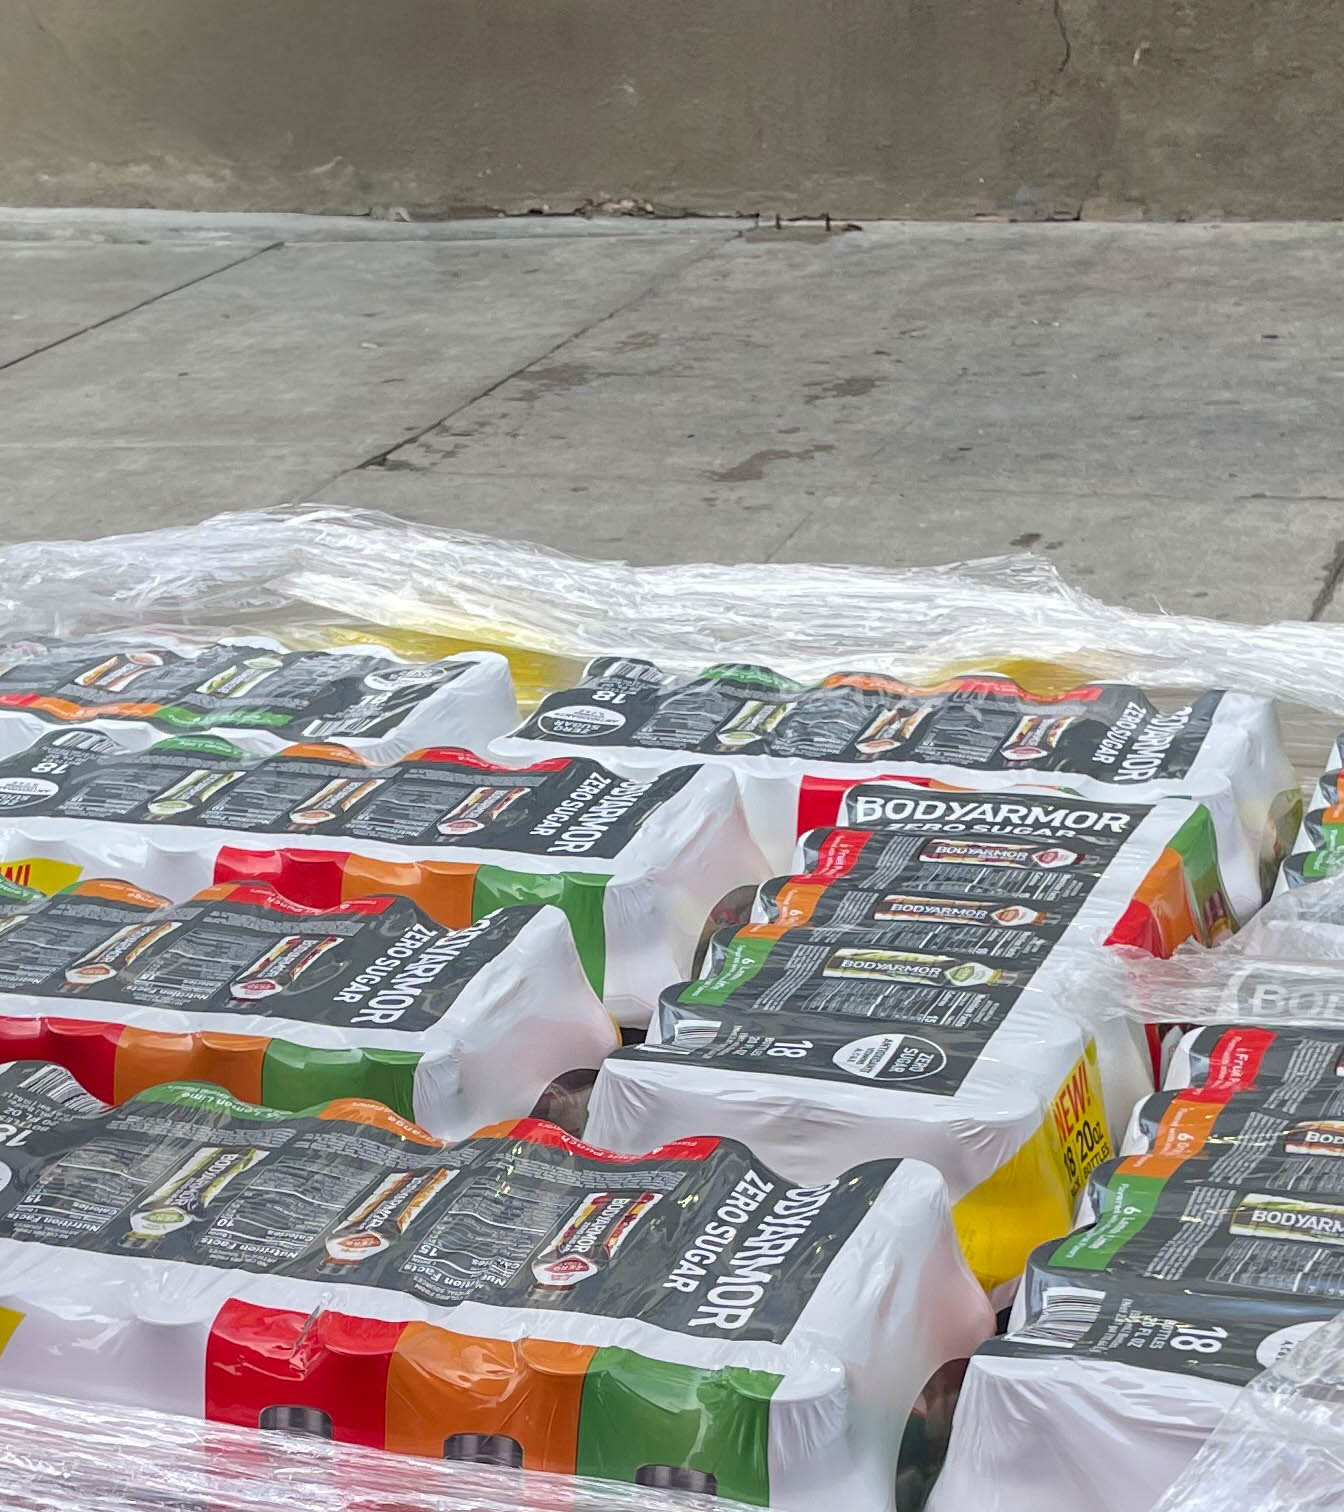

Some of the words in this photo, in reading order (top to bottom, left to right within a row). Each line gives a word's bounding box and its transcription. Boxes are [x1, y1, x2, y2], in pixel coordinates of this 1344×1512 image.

[592, 690, 627, 704] 18
[1116, 701, 1147, 730] ZERO
[1092, 725, 1133, 764] SUGAR
[569, 771, 612, 801] ZERO
[529, 800, 585, 836] SUGAR
[856, 797, 1131, 834] BODYARMOR
[887, 823, 956, 834] ZERO
[964, 823, 1077, 839] SUGAR
[935, 846, 1028, 860] BODYARMOR
[889, 903, 988, 919] BODYARMOR
[387, 923, 438, 957] ZERO
[337, 957, 401, 1004] SUGAR
[841, 959, 942, 979] BODYARMOR
[766, 1040, 810, 1059] 18
[1052, 1060, 1091, 1147] NEW!
[1063, 1145, 1076, 1179] 18
[1082, 1142, 1111, 1179] BOTTLES
[72, 1200, 118, 1216] Calories
[717, 1169, 775, 1224] ZERO
[6, 1211, 43, 1226] Facts
[1124, 1206, 1142, 1215] 6
[48, 1215, 101, 1233] Nutrition
[267, 1229, 315, 1242] Calories
[576, 1197, 632, 1254] BODYARMOR
[199, 1237, 243, 1254] Facts
[245, 1242, 299, 1259] Nutrition
[418, 1244, 439, 1257] 15
[662, 1222, 737, 1293] SUGAR
[1170, 1326, 1229, 1353] 18
